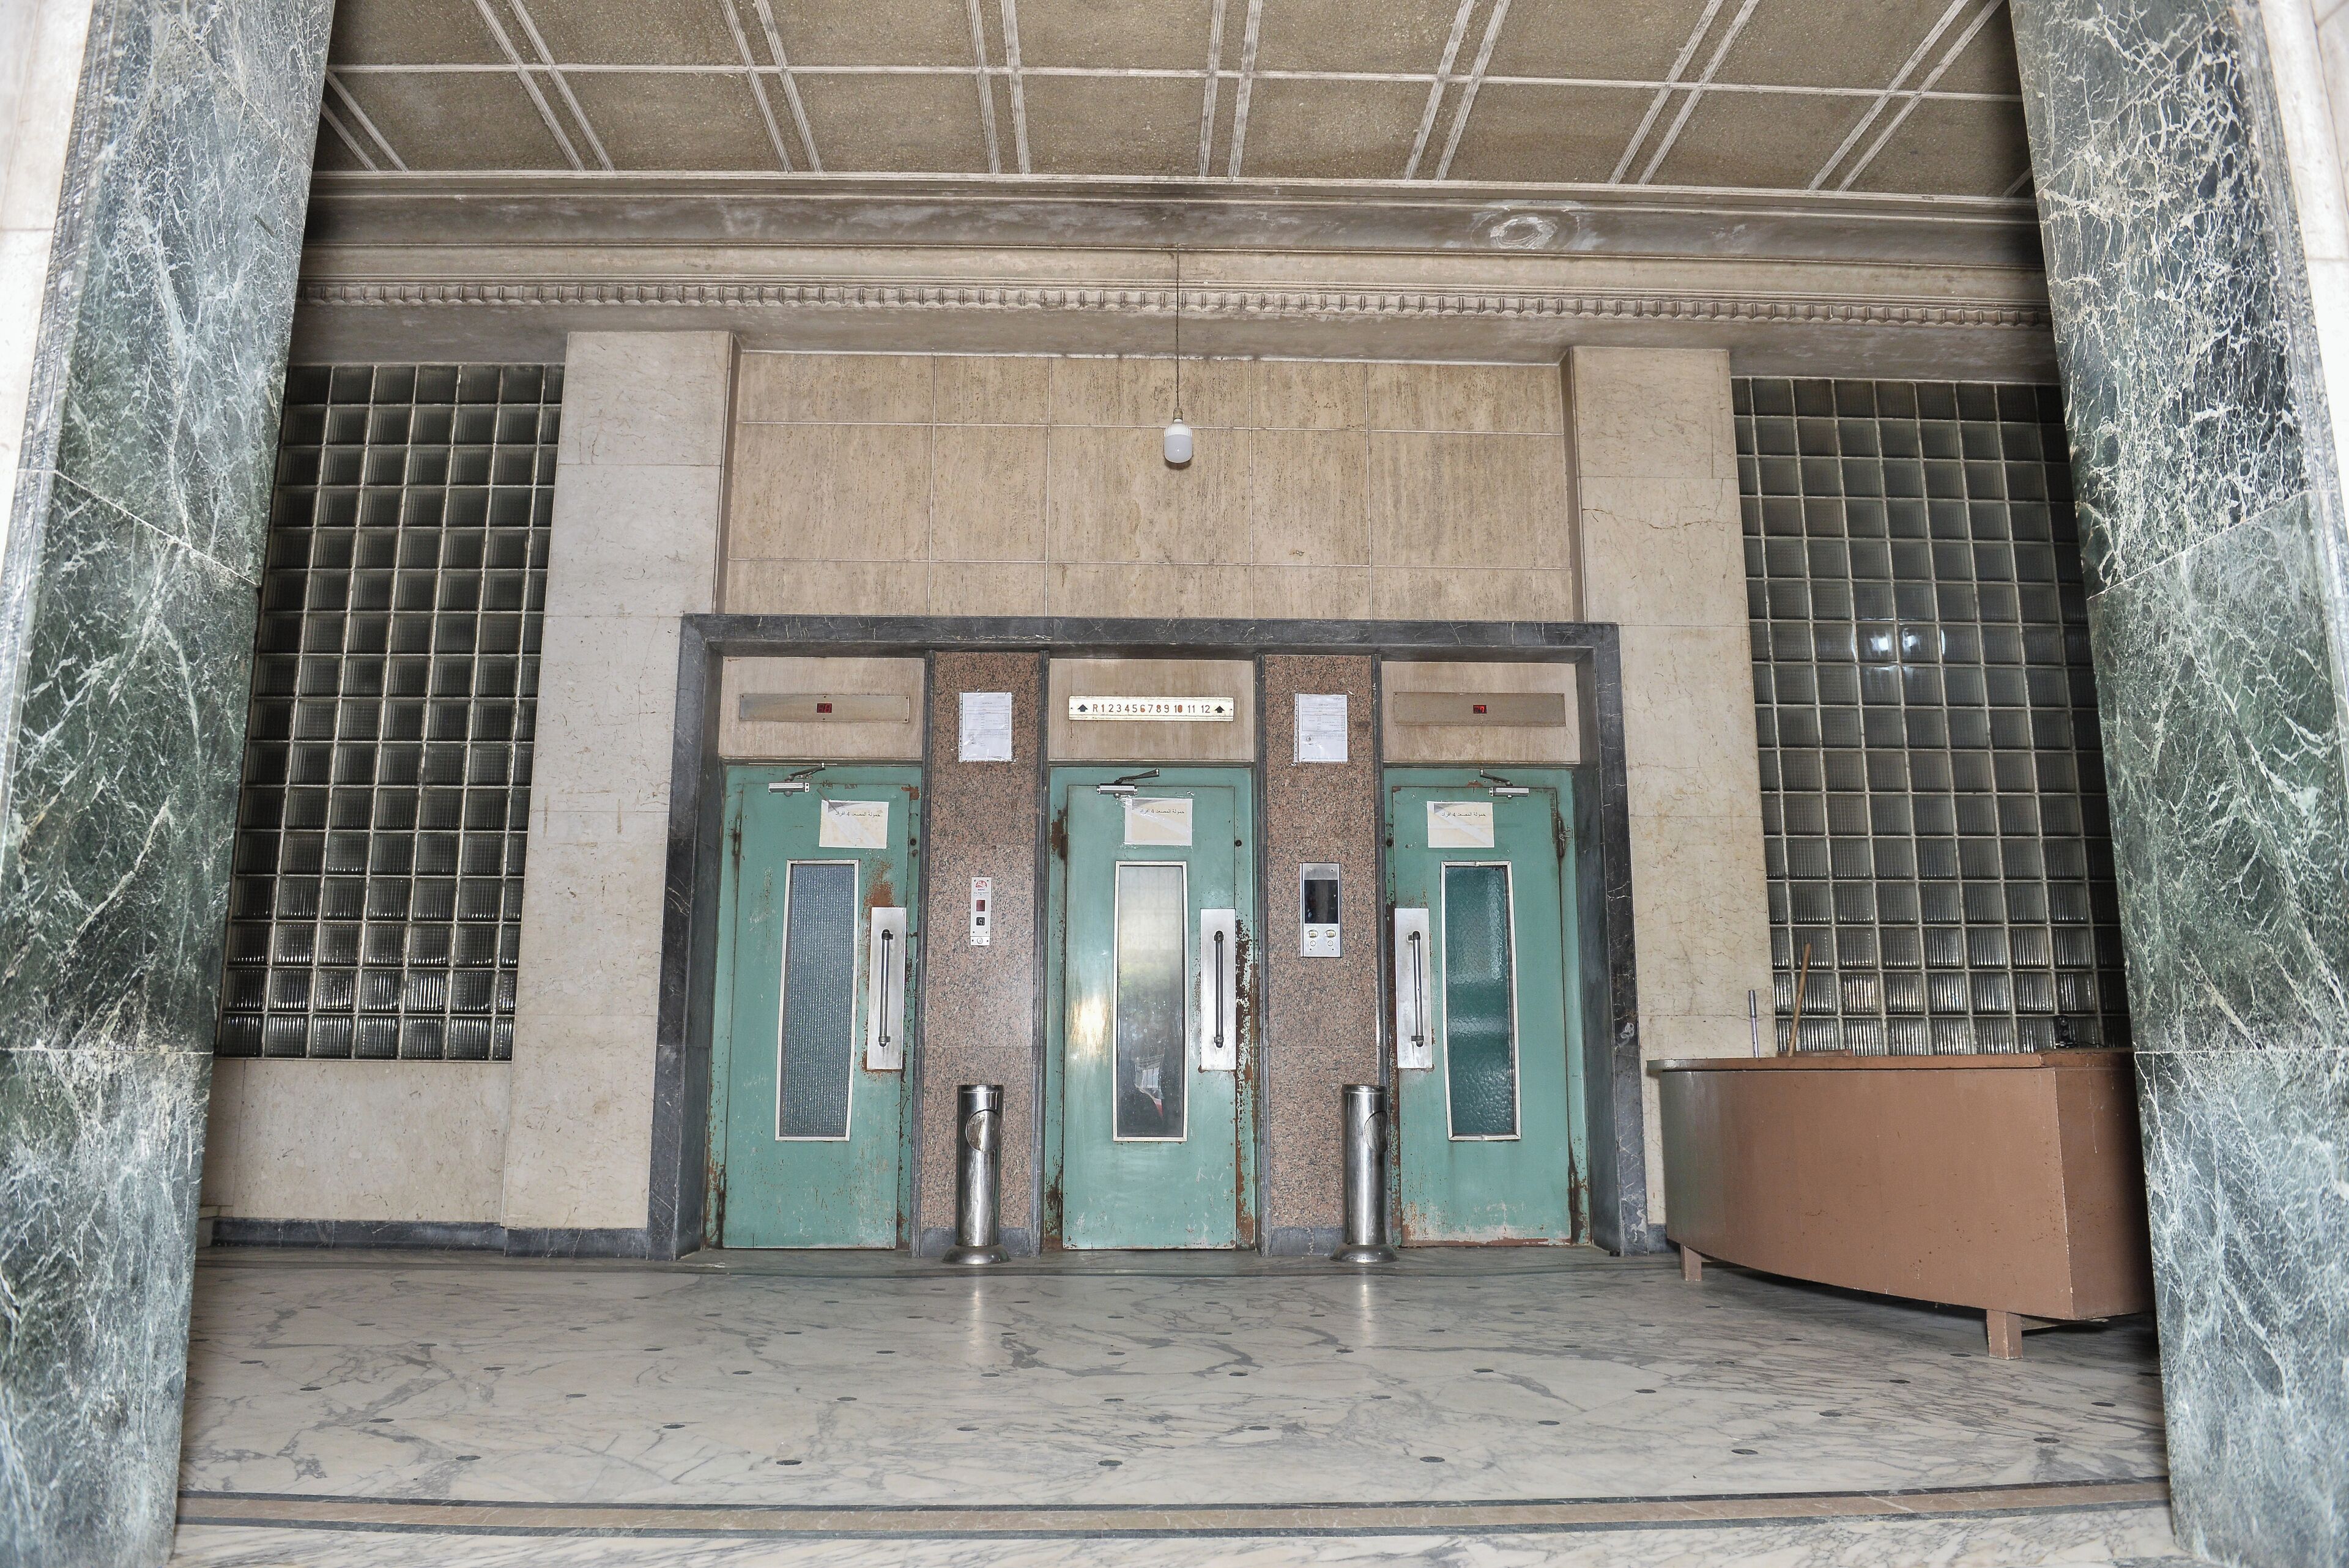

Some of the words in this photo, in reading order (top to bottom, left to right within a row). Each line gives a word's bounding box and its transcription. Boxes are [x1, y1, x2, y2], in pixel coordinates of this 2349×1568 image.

[1108, 704, 1114, 713] 2
[1116, 704, 1121, 713] 3
[1124, 704, 1130, 713] 4
[1132, 704, 1138, 713] 5
[1140, 704, 1145, 713] 6
[1148, 704, 1153, 713] 7
[1156, 704, 1161, 713] 8
[1164, 704, 1169, 713] 9
[1174, 704, 1182, 713] 10
[1188, 705, 1195, 713] 11
[1201, 705, 1210, 713] 12
